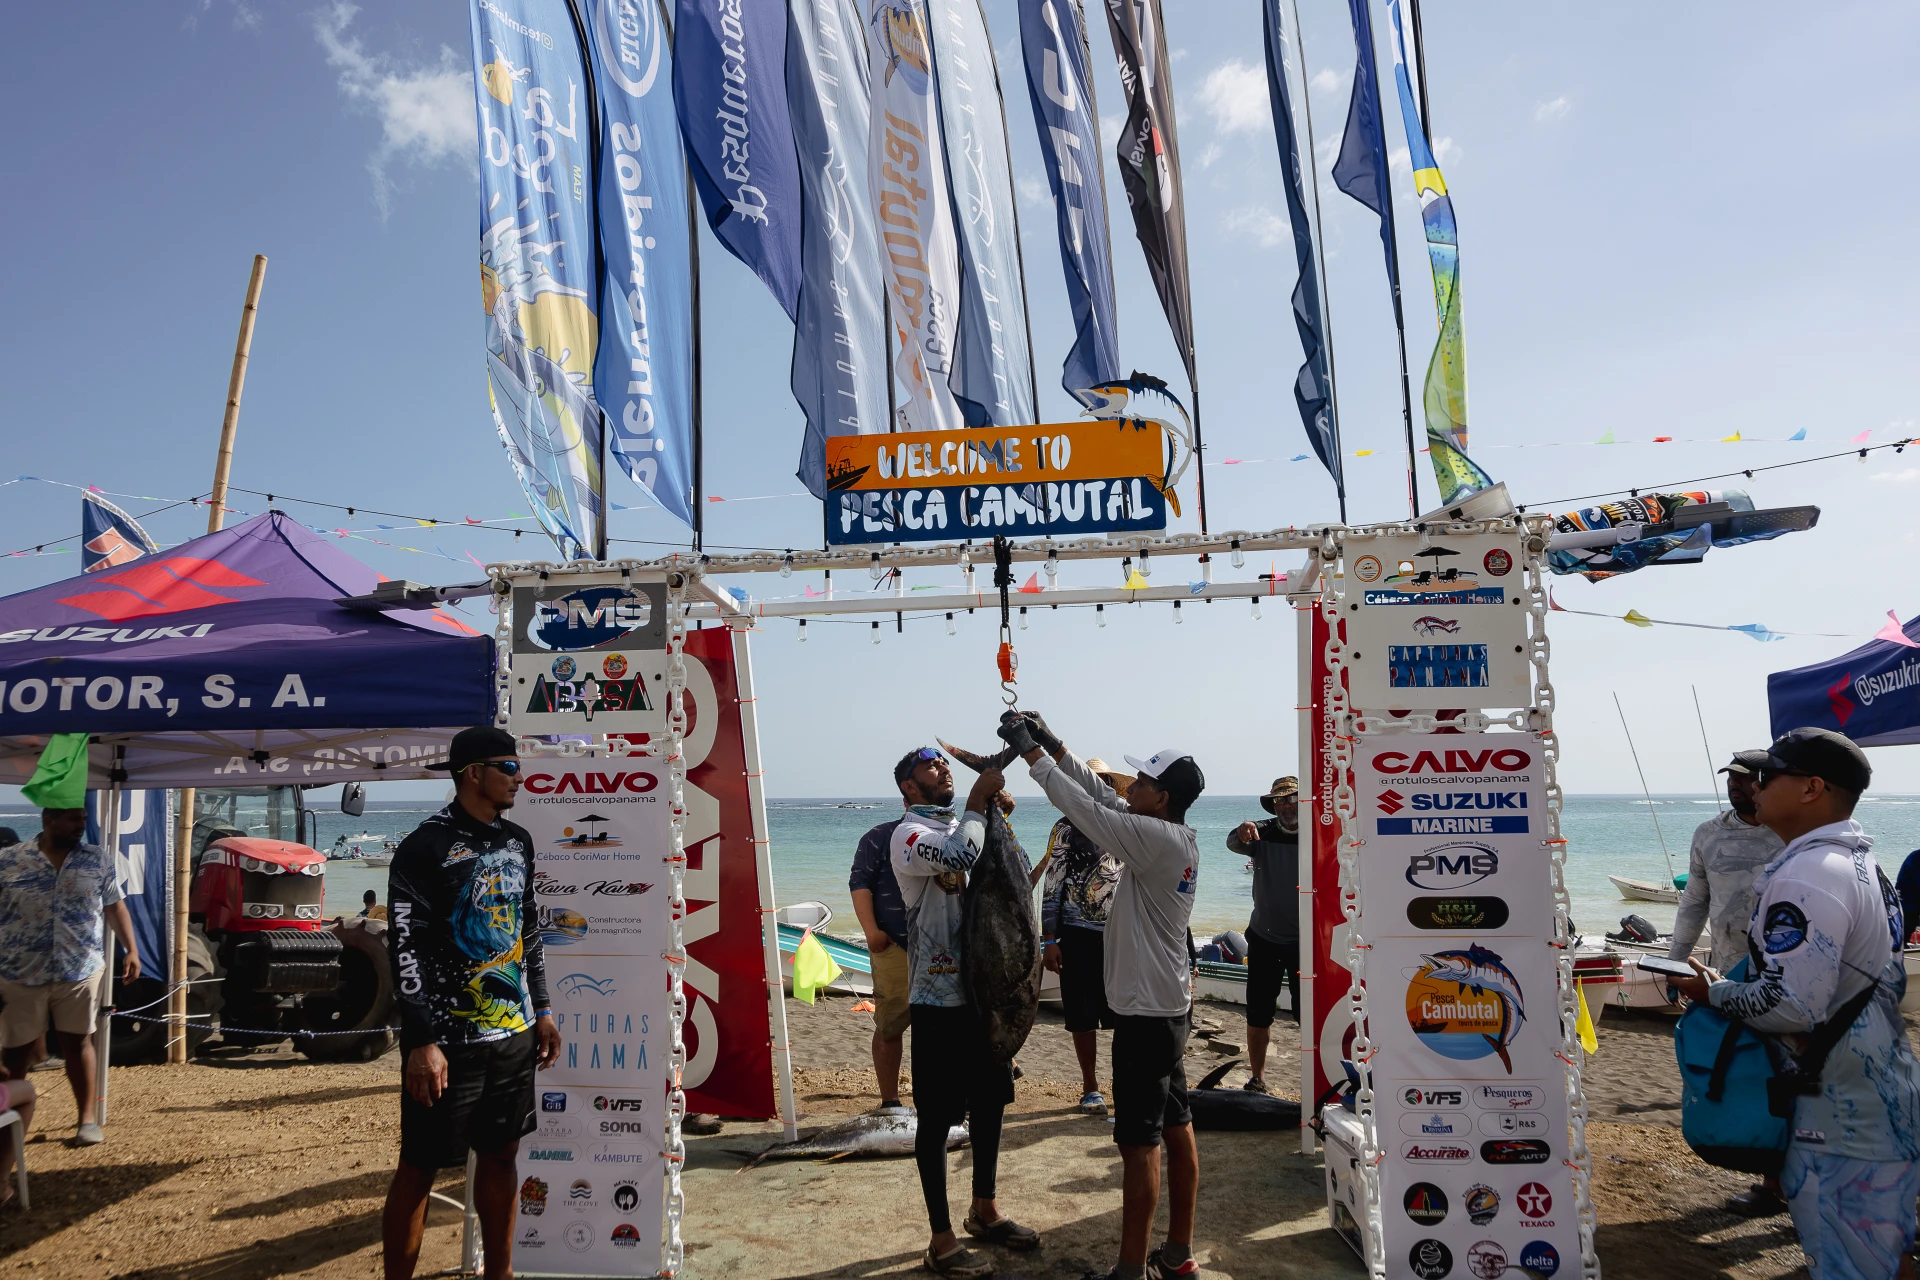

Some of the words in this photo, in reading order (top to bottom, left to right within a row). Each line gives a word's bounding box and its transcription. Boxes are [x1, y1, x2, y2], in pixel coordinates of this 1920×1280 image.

[878, 437, 1022, 479] WELCOME
[1032, 434, 1071, 471] TO
[840, 489, 948, 534] PESCA
[960, 478, 1153, 526] CAMBUTAL
[0, 623, 215, 643] SUZUKI
[1389, 645, 1488, 662] CAPTURAS
[1391, 663, 1489, 687] PANAMÁ
[0, 675, 179, 717] OTOR,
[202, 674, 251, 708] S.
[271, 674, 326, 708] A.
[1372, 749, 1531, 774] CALVO
[524, 772, 658, 794] CALVO
[1379, 775, 1530, 787] @rotuloscalvopanama
[528, 796, 656, 805] @rotuloscalvopanama
[1411, 792, 1528, 811] SUZUKI
[1411, 818, 1493, 833] MARINE
[536, 851, 570, 861] Cébaco
[573, 851, 610, 861] CoriMar
[613, 852, 641, 861] Home
[1410, 855, 1498, 875] PMS
[1437, 904, 1477, 914] H&H
[588, 916, 642, 924] Constructora
[399, 949, 422, 995] CAP.
[1430, 992, 1455, 1004] Pesca
[1422, 1000, 1498, 1020] Cambutal
[558, 1013, 649, 1034] PTURAS
[568, 1040, 648, 1070] NAMÁ
[1482, 1086, 1533, 1099] Pesqueros
[600, 1121, 641, 1134] sona
[1518, 1120, 1536, 1128] R&S
[528, 1150, 574, 1161] DANIEL
[1406, 1145, 1470, 1159] Accurate
[1525, 1255, 1553, 1266] delta
